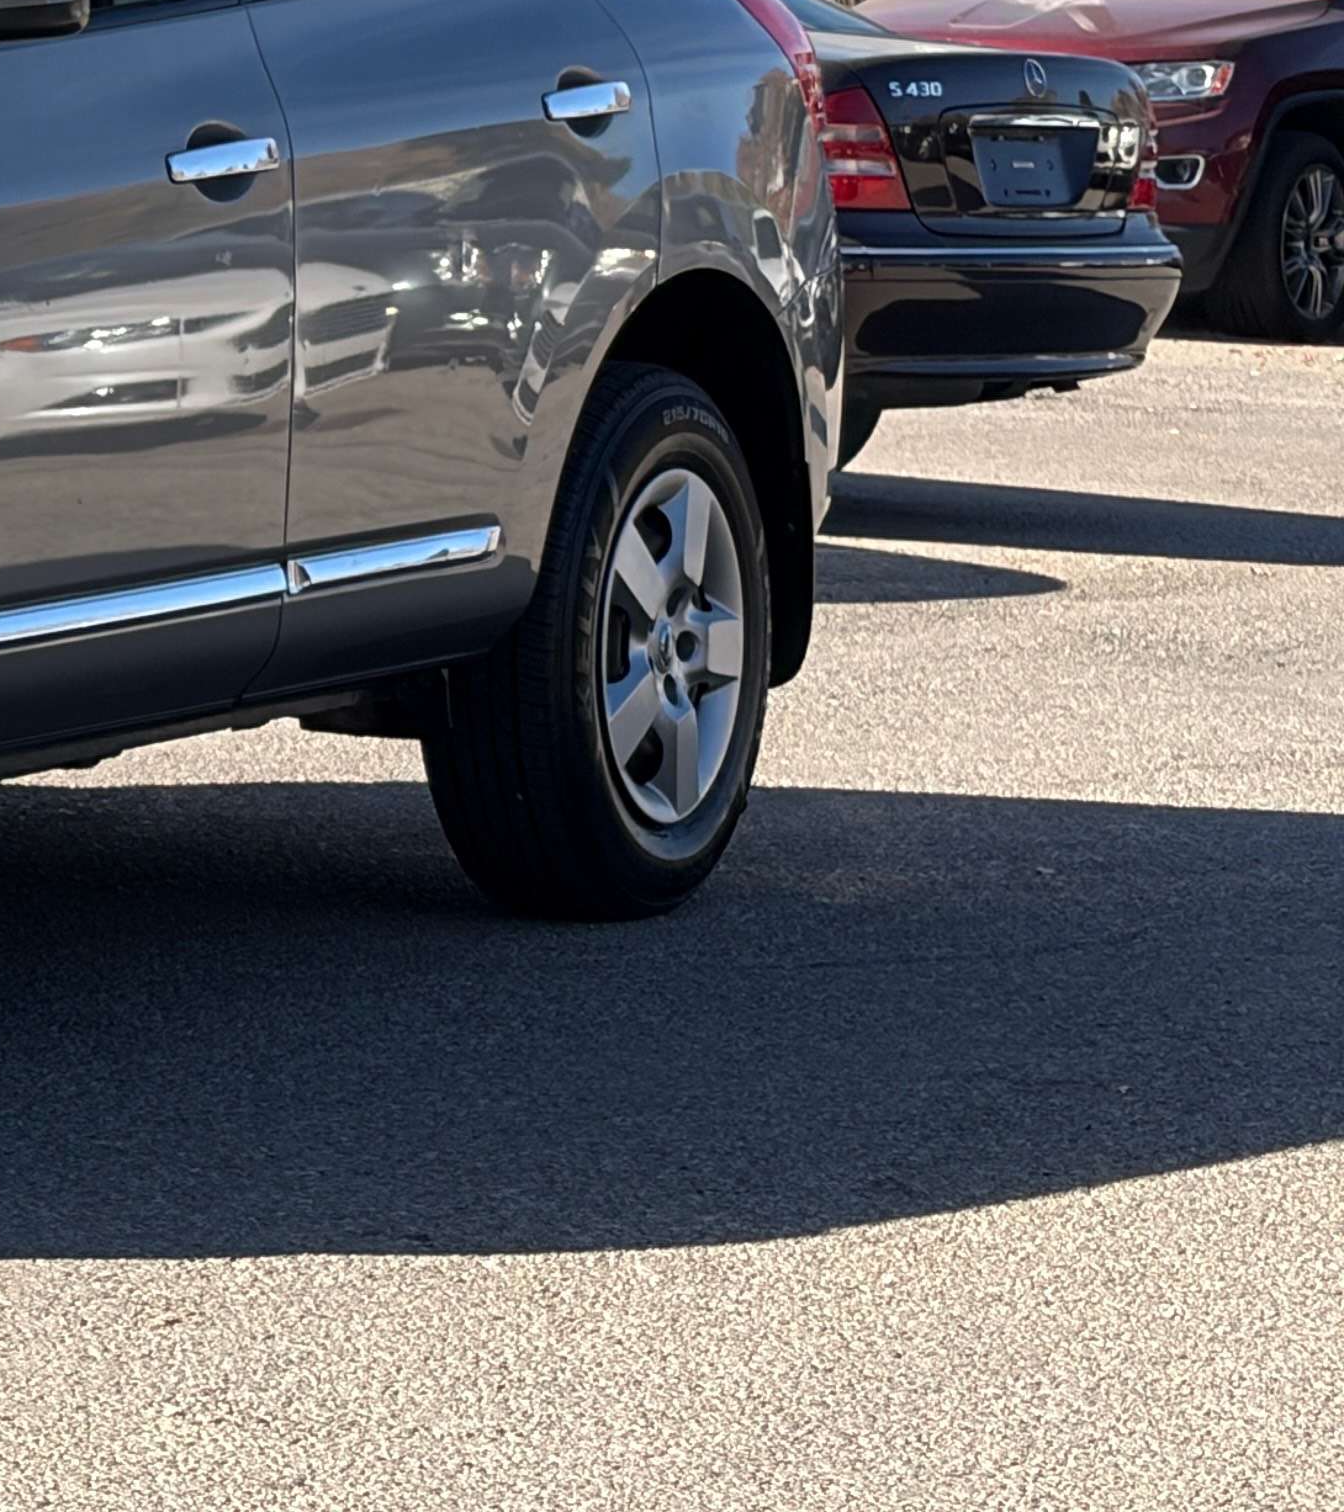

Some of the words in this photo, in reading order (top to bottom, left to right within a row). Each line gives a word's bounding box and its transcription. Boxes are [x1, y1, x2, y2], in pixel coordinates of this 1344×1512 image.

[888, 81, 903, 97] S
[905, 81, 943, 97] 430
[577, 525, 603, 723] KELLY
